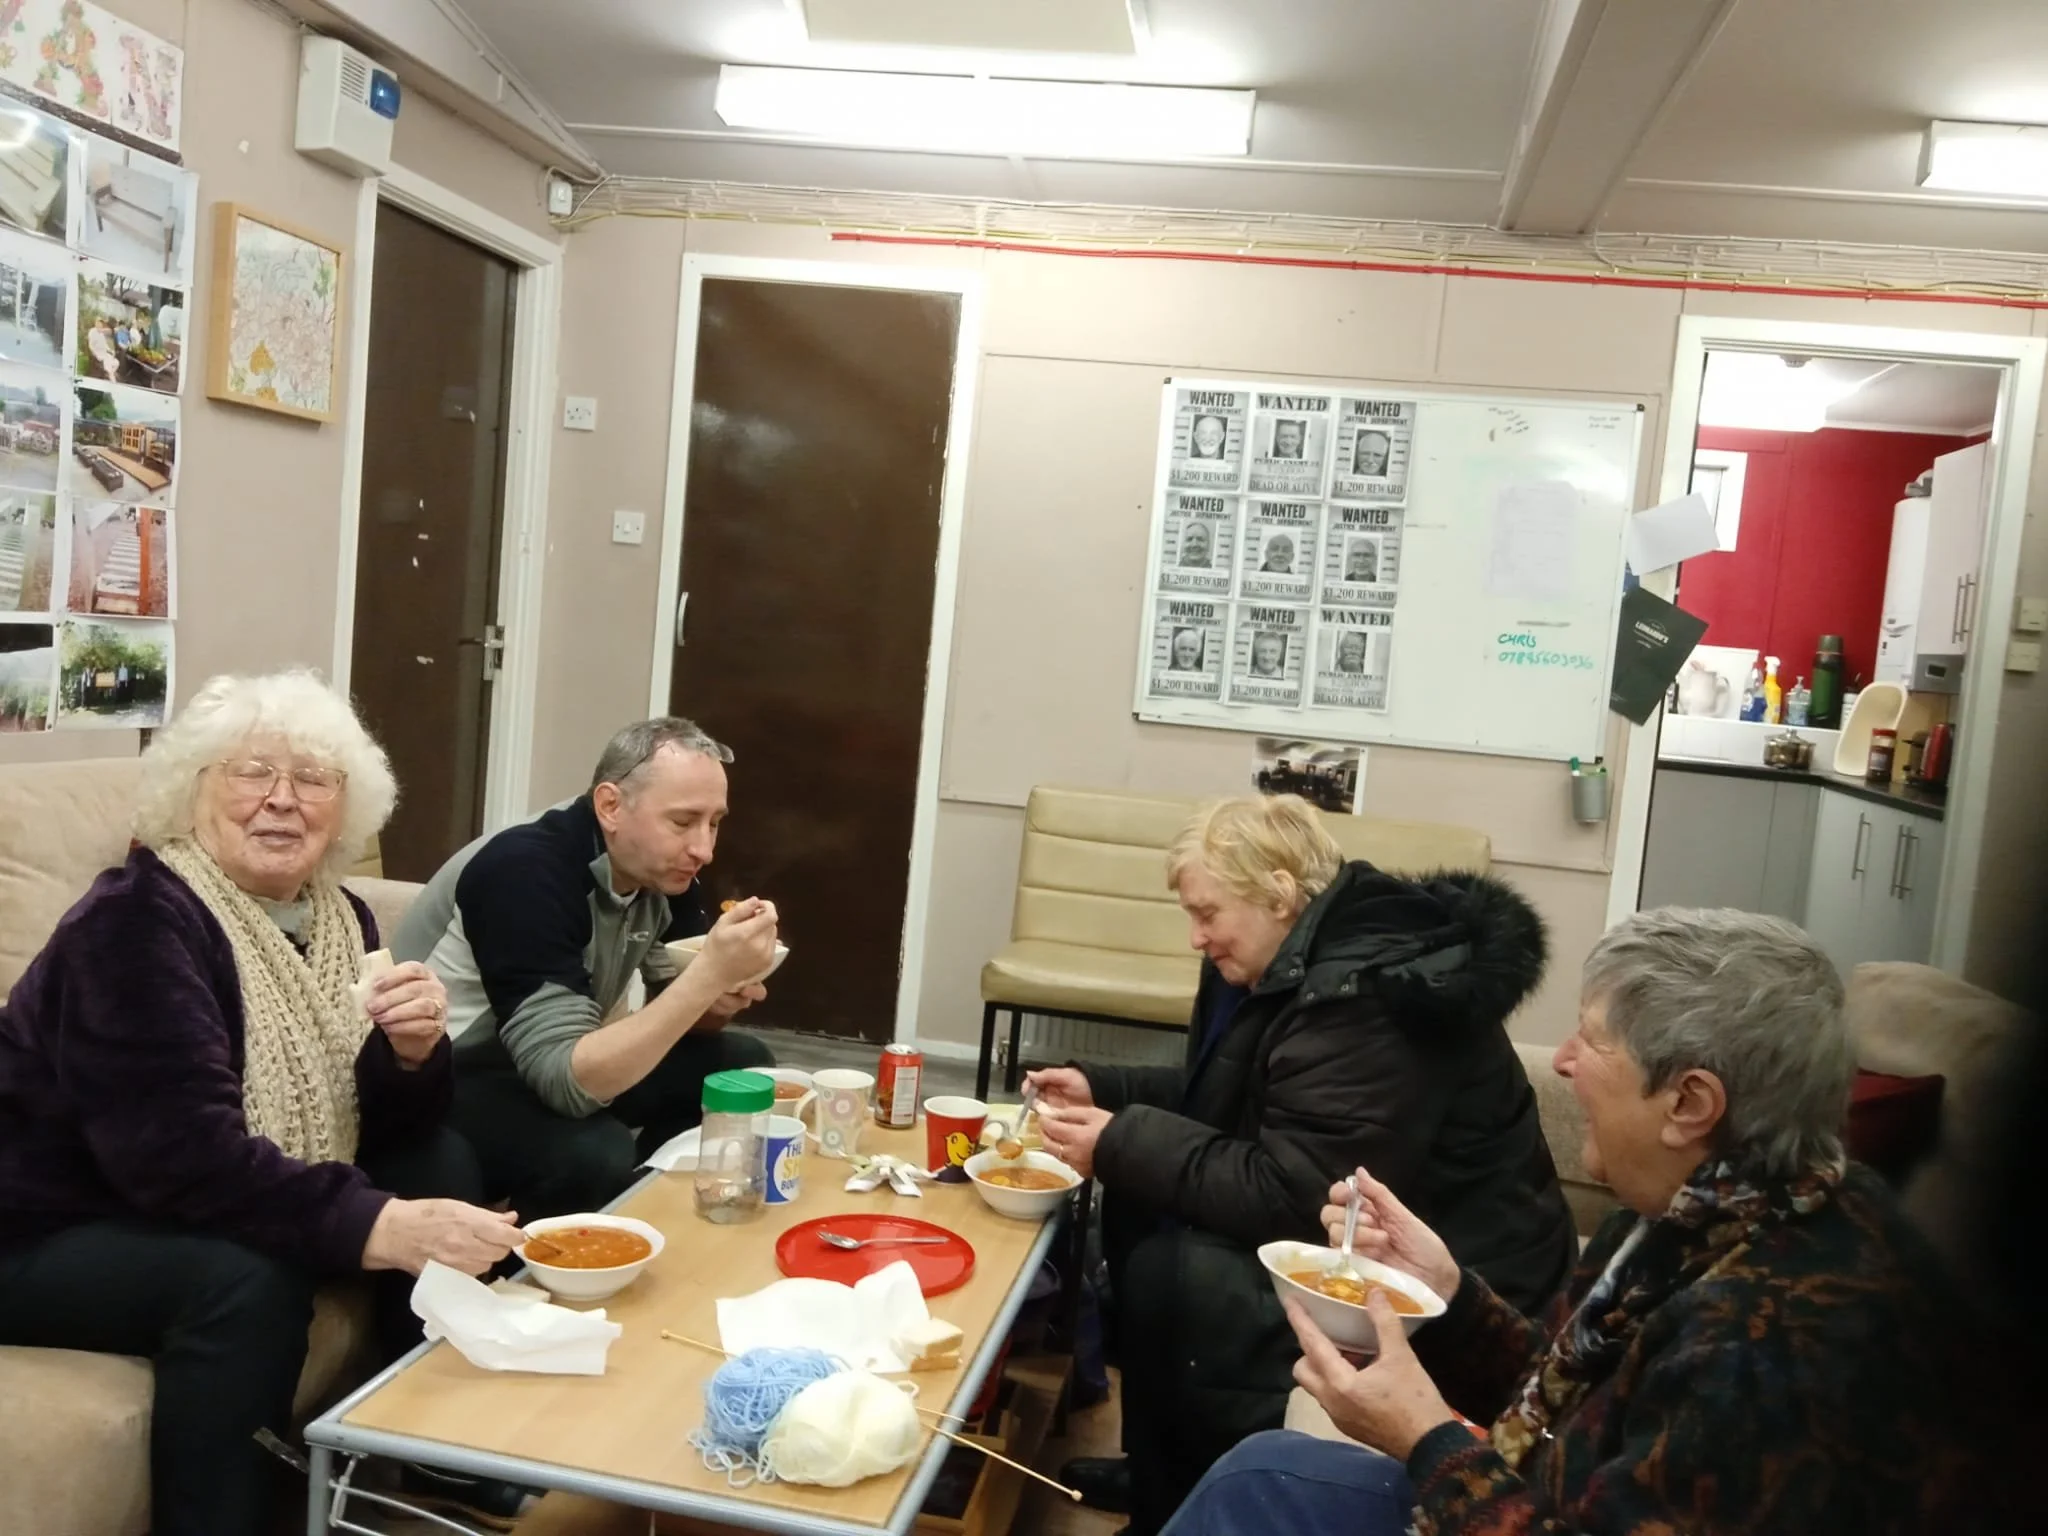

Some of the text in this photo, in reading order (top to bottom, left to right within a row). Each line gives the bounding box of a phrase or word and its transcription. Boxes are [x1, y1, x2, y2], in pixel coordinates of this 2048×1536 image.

[1189, 391, 1235, 407] WANTED
[1259, 395, 1328, 412] WANTED
[1354, 400, 1401, 417] WANTED
[1203, 471, 1239, 483] REWARD
[1249, 480, 1317, 494] DEAD OR ALIVE
[1367, 482, 1404, 494] REWARD
[1179, 496, 1225, 512] WANTED
[1260, 502, 1306, 518] WANTED
[1342, 508, 1389, 524] WANTED
[1192, 575, 1229, 587] REWARD
[1275, 583, 1310, 594] REWARD
[1357, 590, 1394, 601] REWARD
[1169, 601, 1215, 618] WANTED
[1250, 607, 1296, 624] WANTED
[1321, 610, 1391, 626] WANTED
[1183, 681, 1219, 693] REWARD
[1262, 686, 1299, 700] REWARD
[785, 1143, 802, 1157] THE
